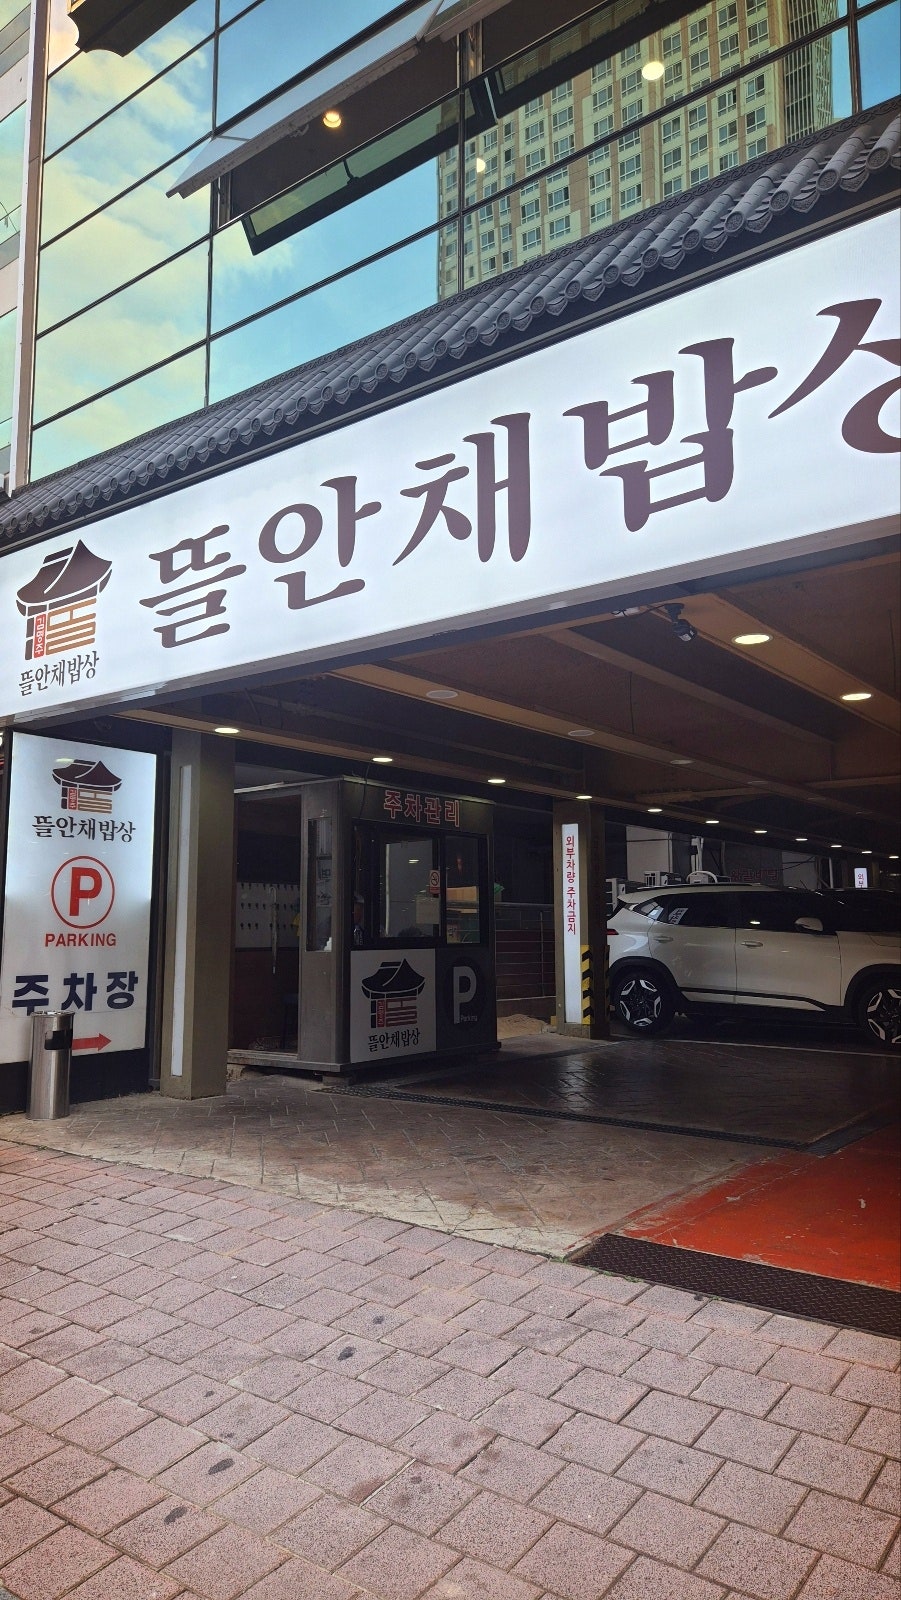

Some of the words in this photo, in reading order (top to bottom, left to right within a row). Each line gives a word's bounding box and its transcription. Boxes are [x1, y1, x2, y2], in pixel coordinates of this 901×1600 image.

[383, 790, 460, 828] 주차관리
[69, 867, 103, 917] P
[45, 933, 117, 947] PARKING
[452, 965, 477, 1025] P
